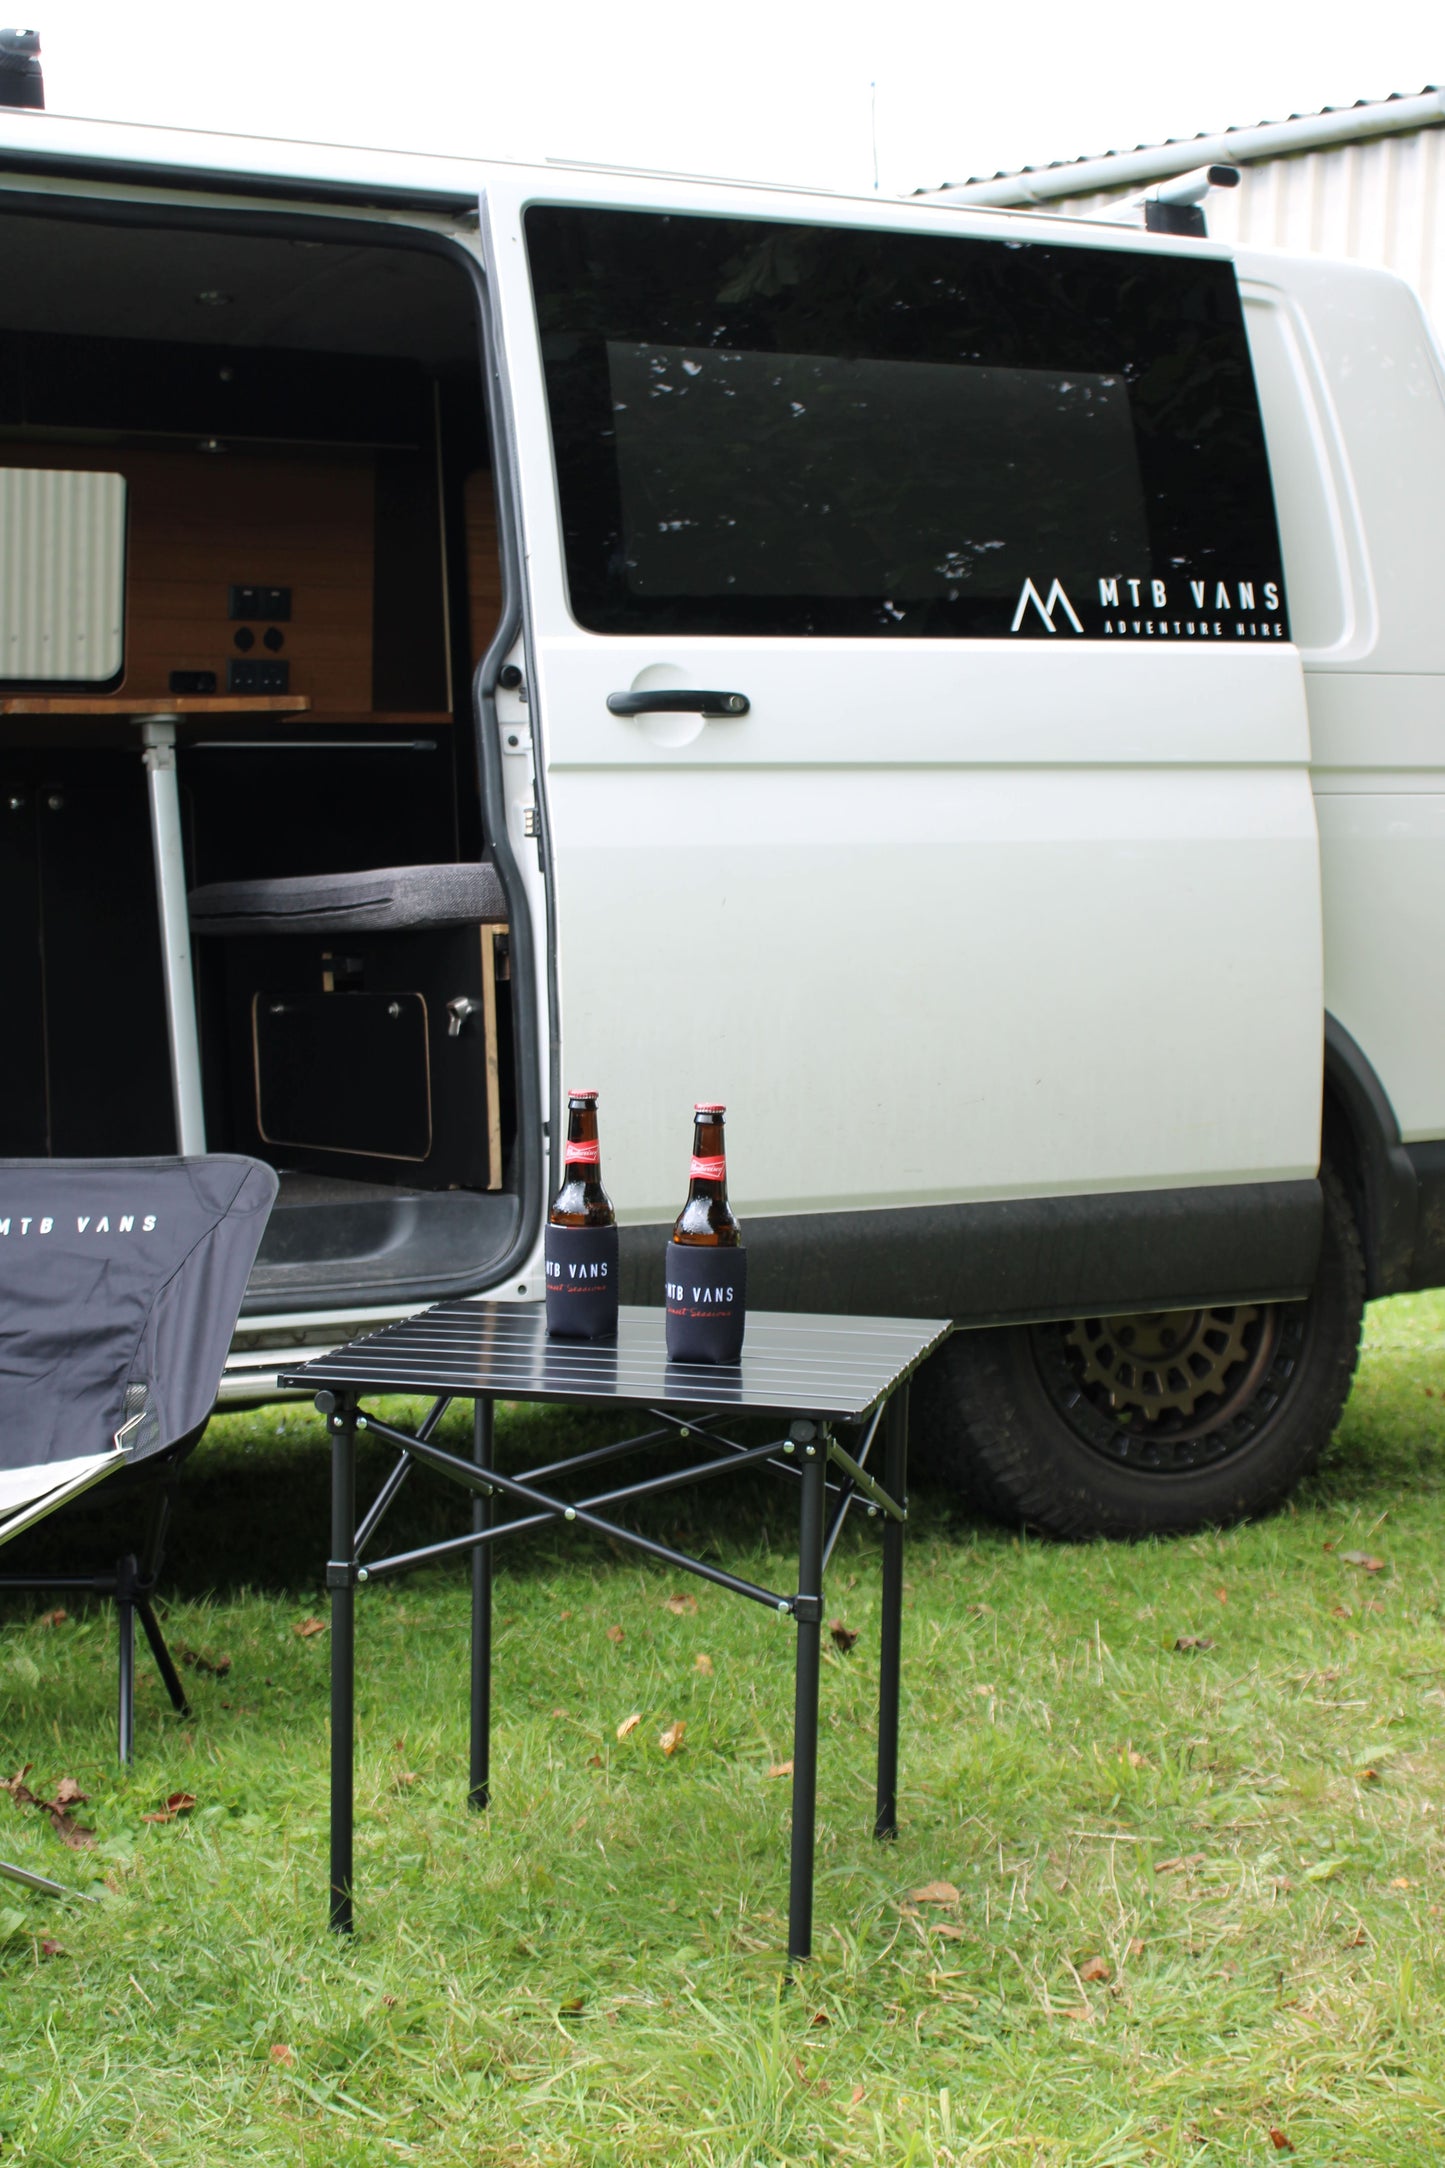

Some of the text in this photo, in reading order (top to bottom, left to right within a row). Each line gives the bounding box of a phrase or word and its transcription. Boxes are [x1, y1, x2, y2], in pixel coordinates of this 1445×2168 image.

[1098, 578, 1280, 610] MTB VANS
[1104, 620, 1283, 637] ADVENTURE HIRE
[0, 1214, 157, 1236] MTB VANS
[568, 1262, 608, 1279] VANS
[692, 1286, 734, 1303] VANS
